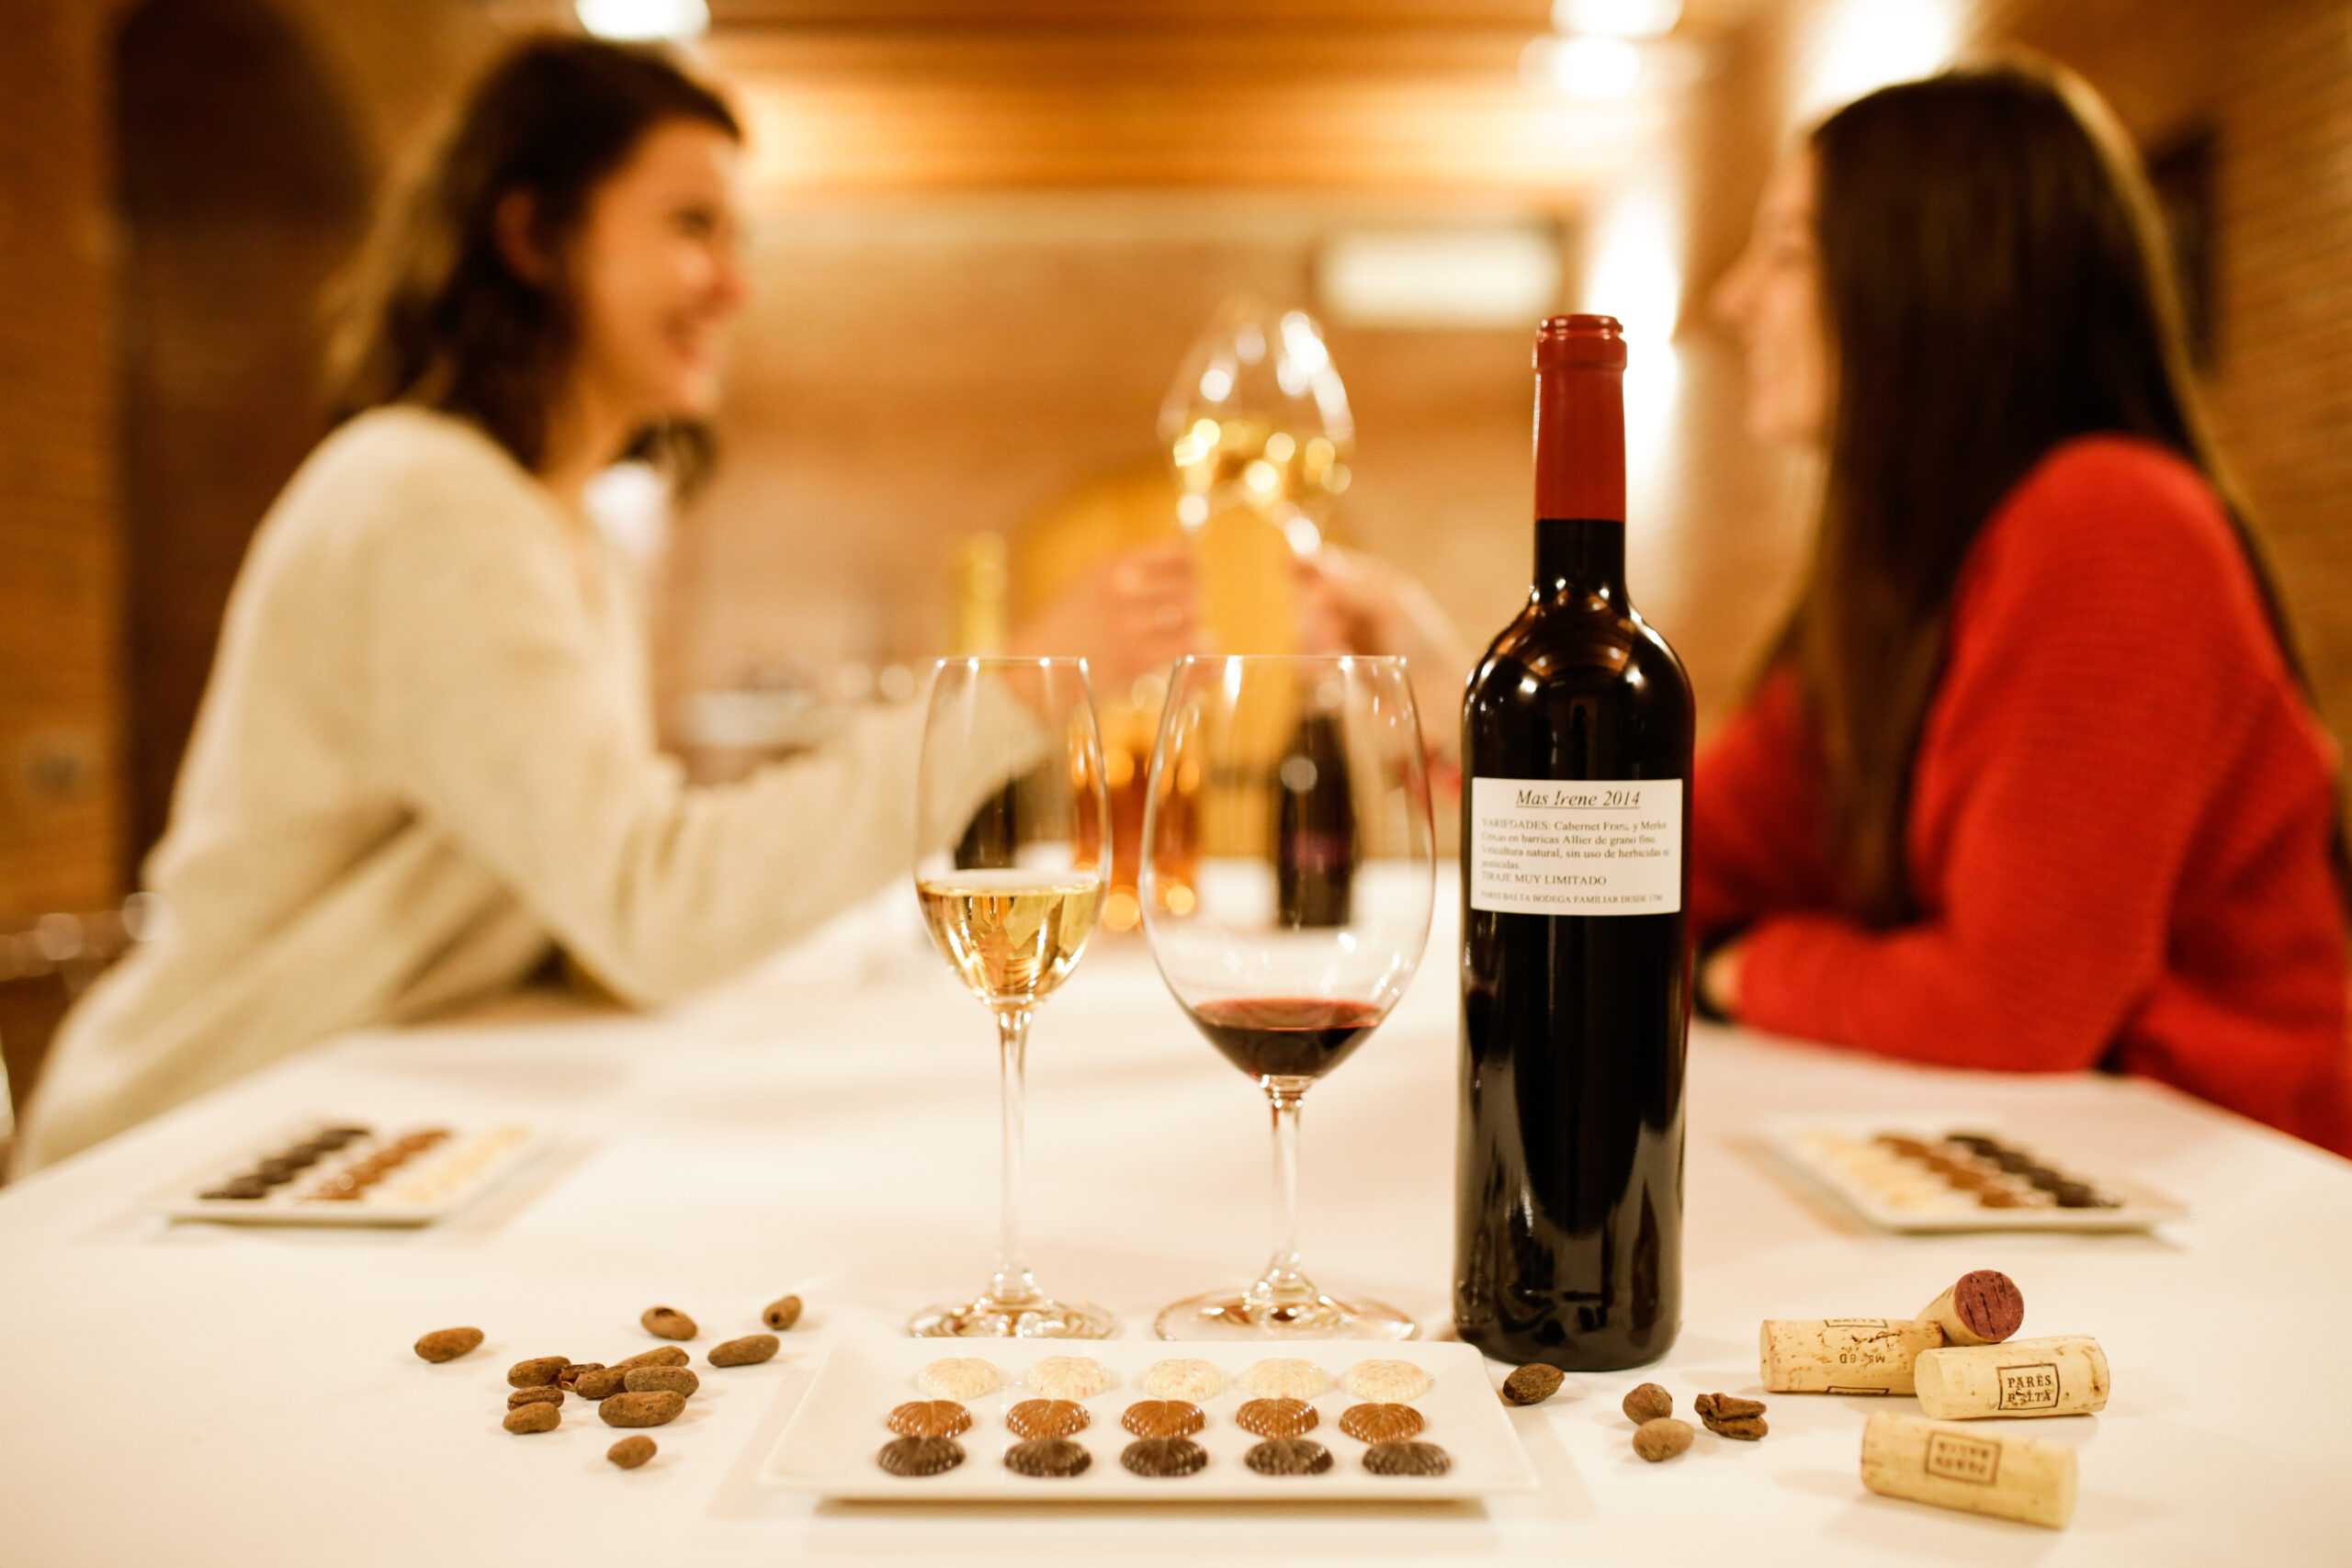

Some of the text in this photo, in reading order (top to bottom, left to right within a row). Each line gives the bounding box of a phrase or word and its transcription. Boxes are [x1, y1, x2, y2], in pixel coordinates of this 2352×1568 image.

[1516, 789, 1641, 807] Mas Irene 2014
[1554, 820, 1600, 831] Cabernet
[1595, 835, 1607, 844] de
[1566, 850, 1581, 858] sin
[1604, 849, 1617, 858] de
[1515, 874, 1542, 884] MUY
[1544, 874, 1608, 886] LIMITADO
[1532, 894, 1572, 903] BODEGA
